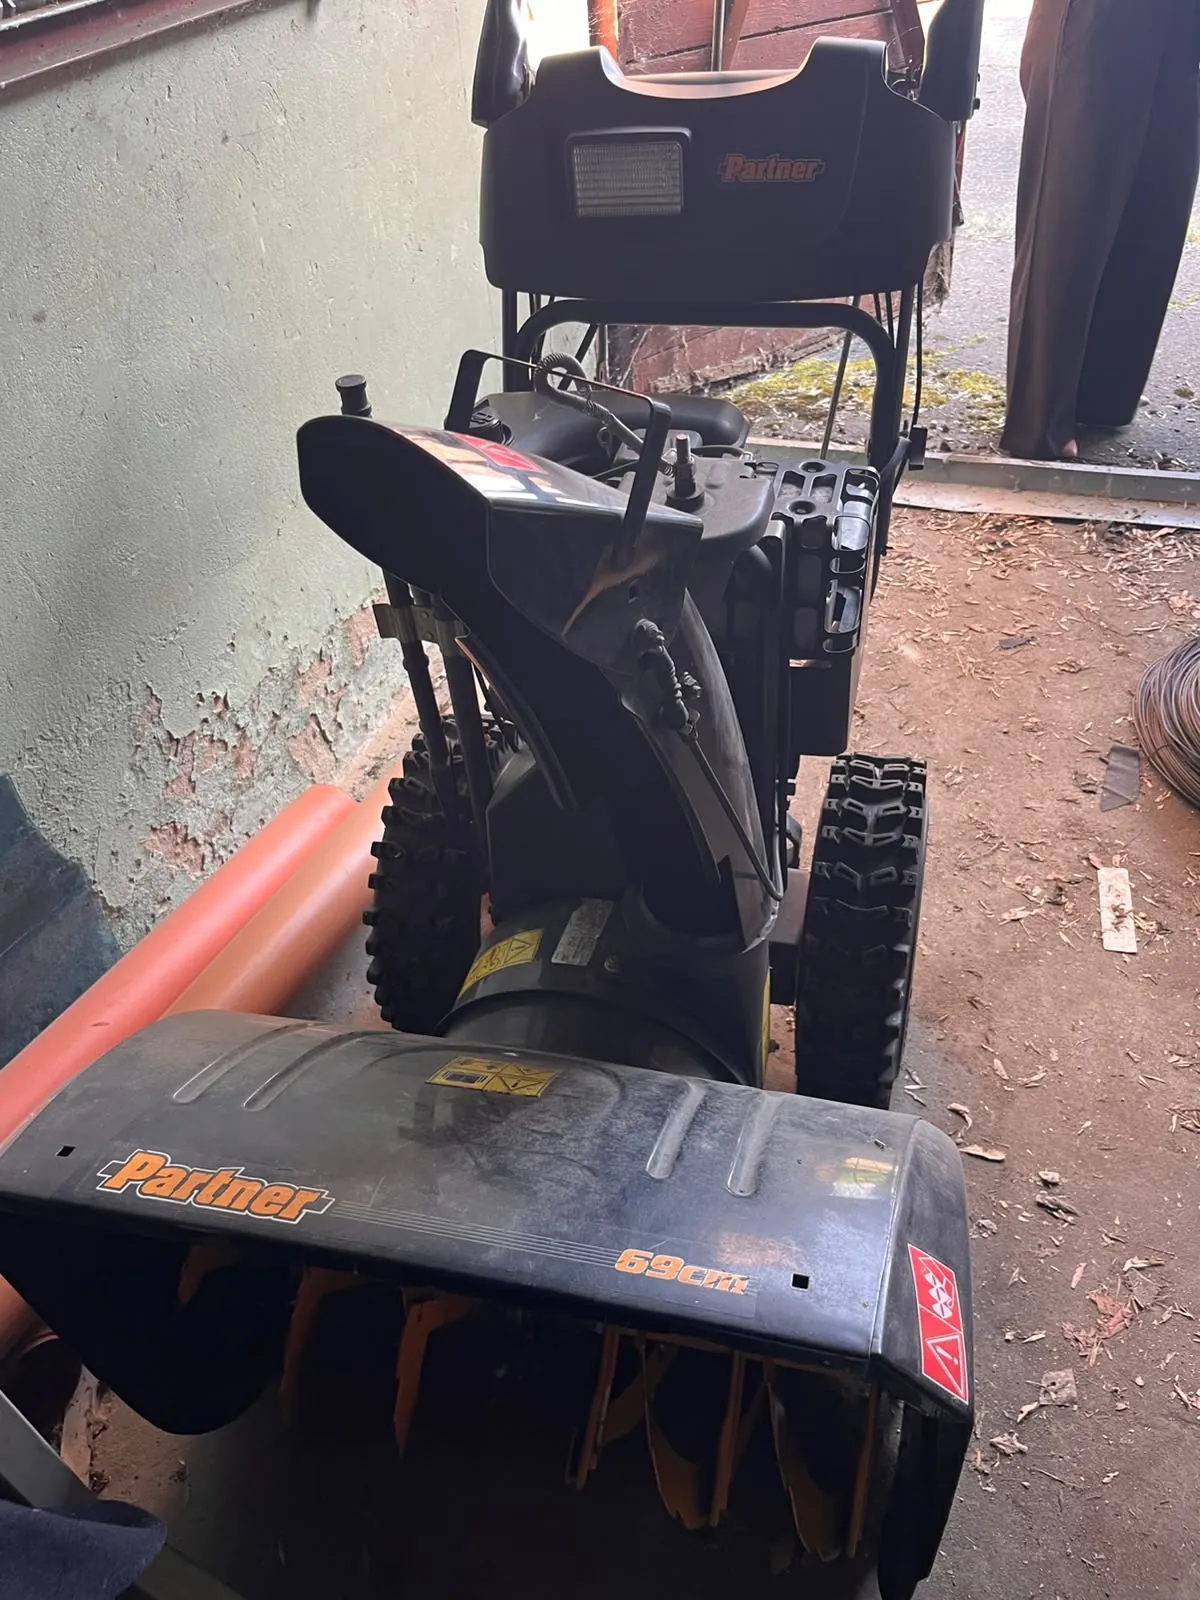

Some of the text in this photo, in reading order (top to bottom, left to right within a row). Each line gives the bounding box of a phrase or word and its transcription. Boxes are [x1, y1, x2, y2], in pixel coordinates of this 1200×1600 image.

[724, 155, 818, 181] Partner
[103, 1151, 321, 1221] Partner
[614, 1249, 749, 1294] 69cm
